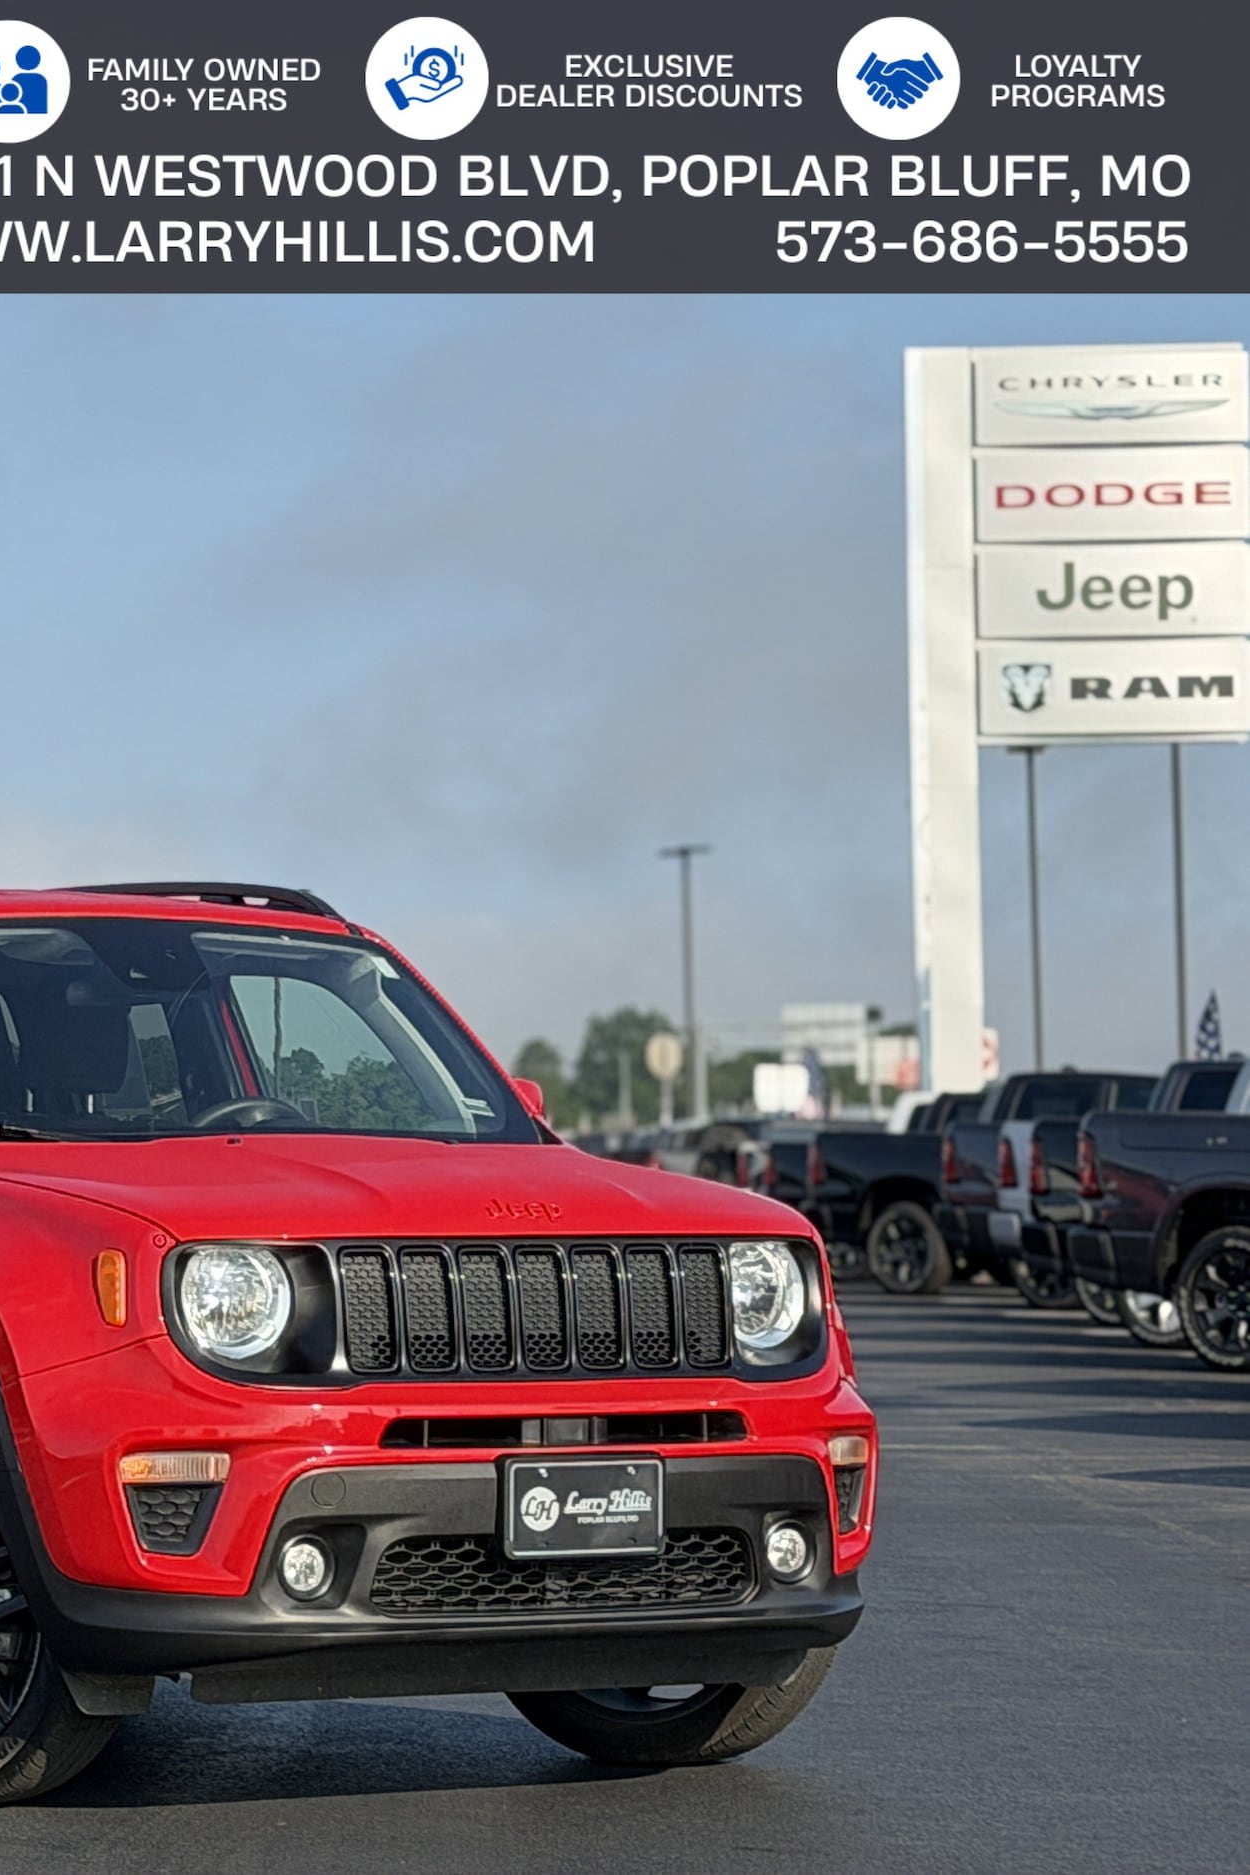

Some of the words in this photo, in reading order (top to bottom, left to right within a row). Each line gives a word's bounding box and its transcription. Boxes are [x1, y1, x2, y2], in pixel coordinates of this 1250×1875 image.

[998, 373, 1224, 392] CHRYSLER
[995, 481, 1232, 509] DODGE
[1036, 561, 1194, 621] Jeep
[1070, 675, 1235, 701] RAM
[485, 1198, 562, 1223] Jeep
[564, 1490, 608, 1515] Larry
[608, 1487, 652, 1511] Hillis
